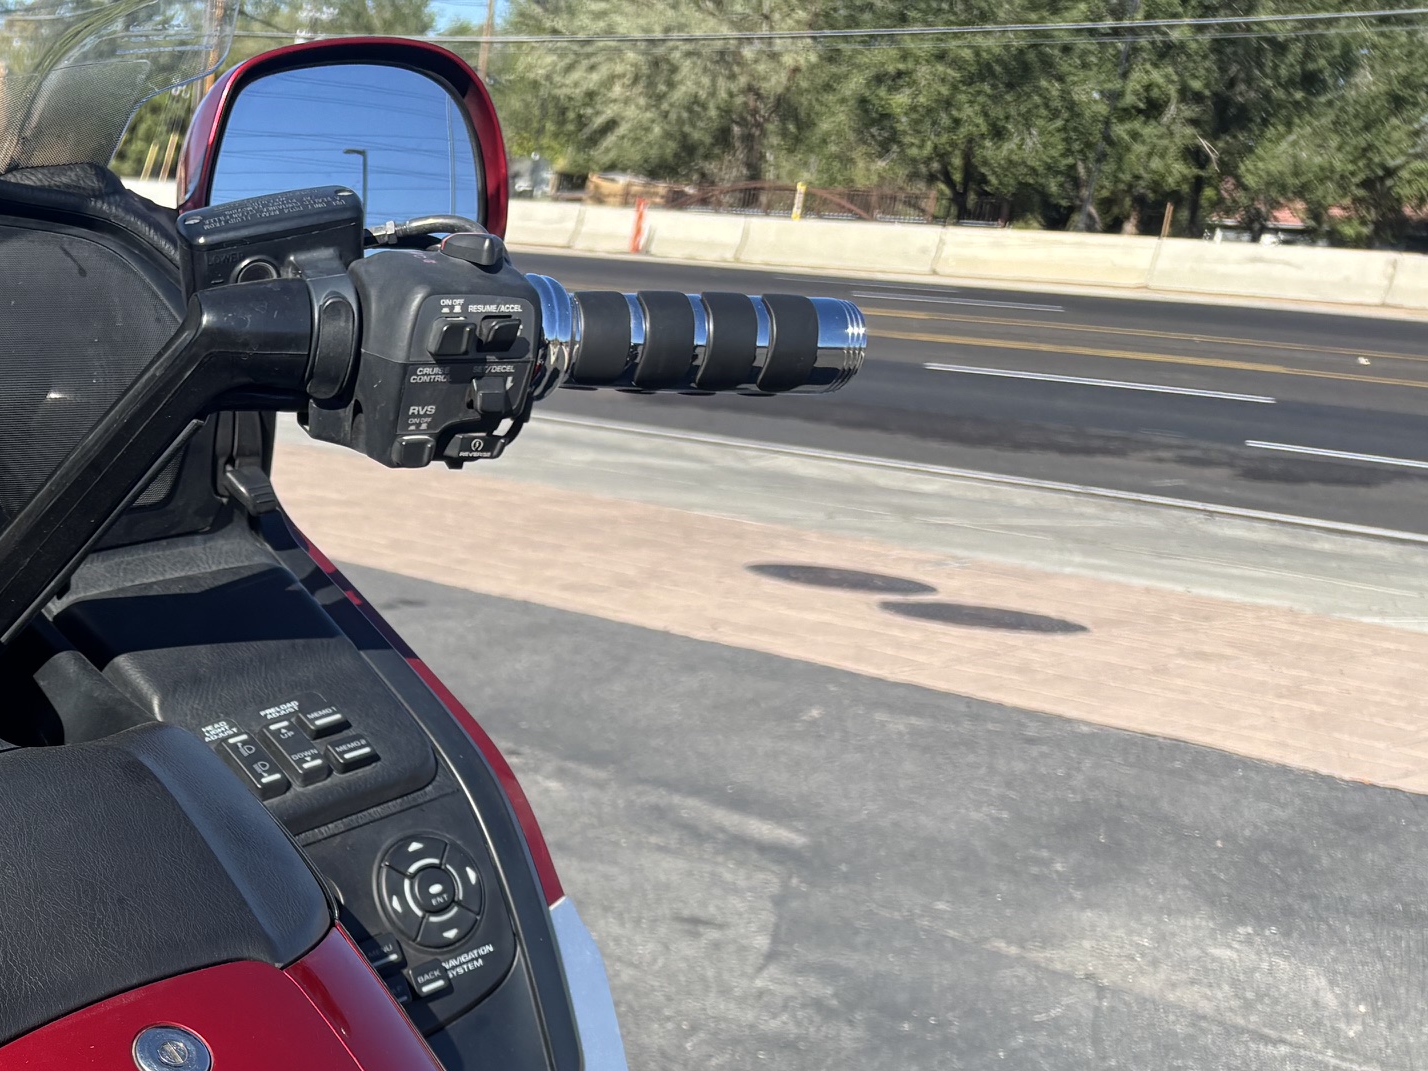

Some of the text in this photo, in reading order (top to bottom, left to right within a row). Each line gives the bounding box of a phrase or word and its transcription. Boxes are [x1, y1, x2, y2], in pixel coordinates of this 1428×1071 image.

[468, 304, 523, 313] RESUME/ACCEL
[417, 367, 450, 375] CRUISE
[409, 405, 436, 415] RVS
[259, 700, 299, 717] PRELOAD
[266, 706, 300, 720] ADJUST
[201, 721, 227, 732] HEAD
[204, 725, 229, 736] LIGHT
[204, 727, 238, 742] ADJUST
[279, 730, 295, 739] UP
[291, 748, 318, 761] DOWN
[431, 894, 449, 906] ENT
[441, 944, 494, 969] NAVIGATION
[447, 958, 483, 979] SYSTEM
[417, 969, 441, 984] BACK
